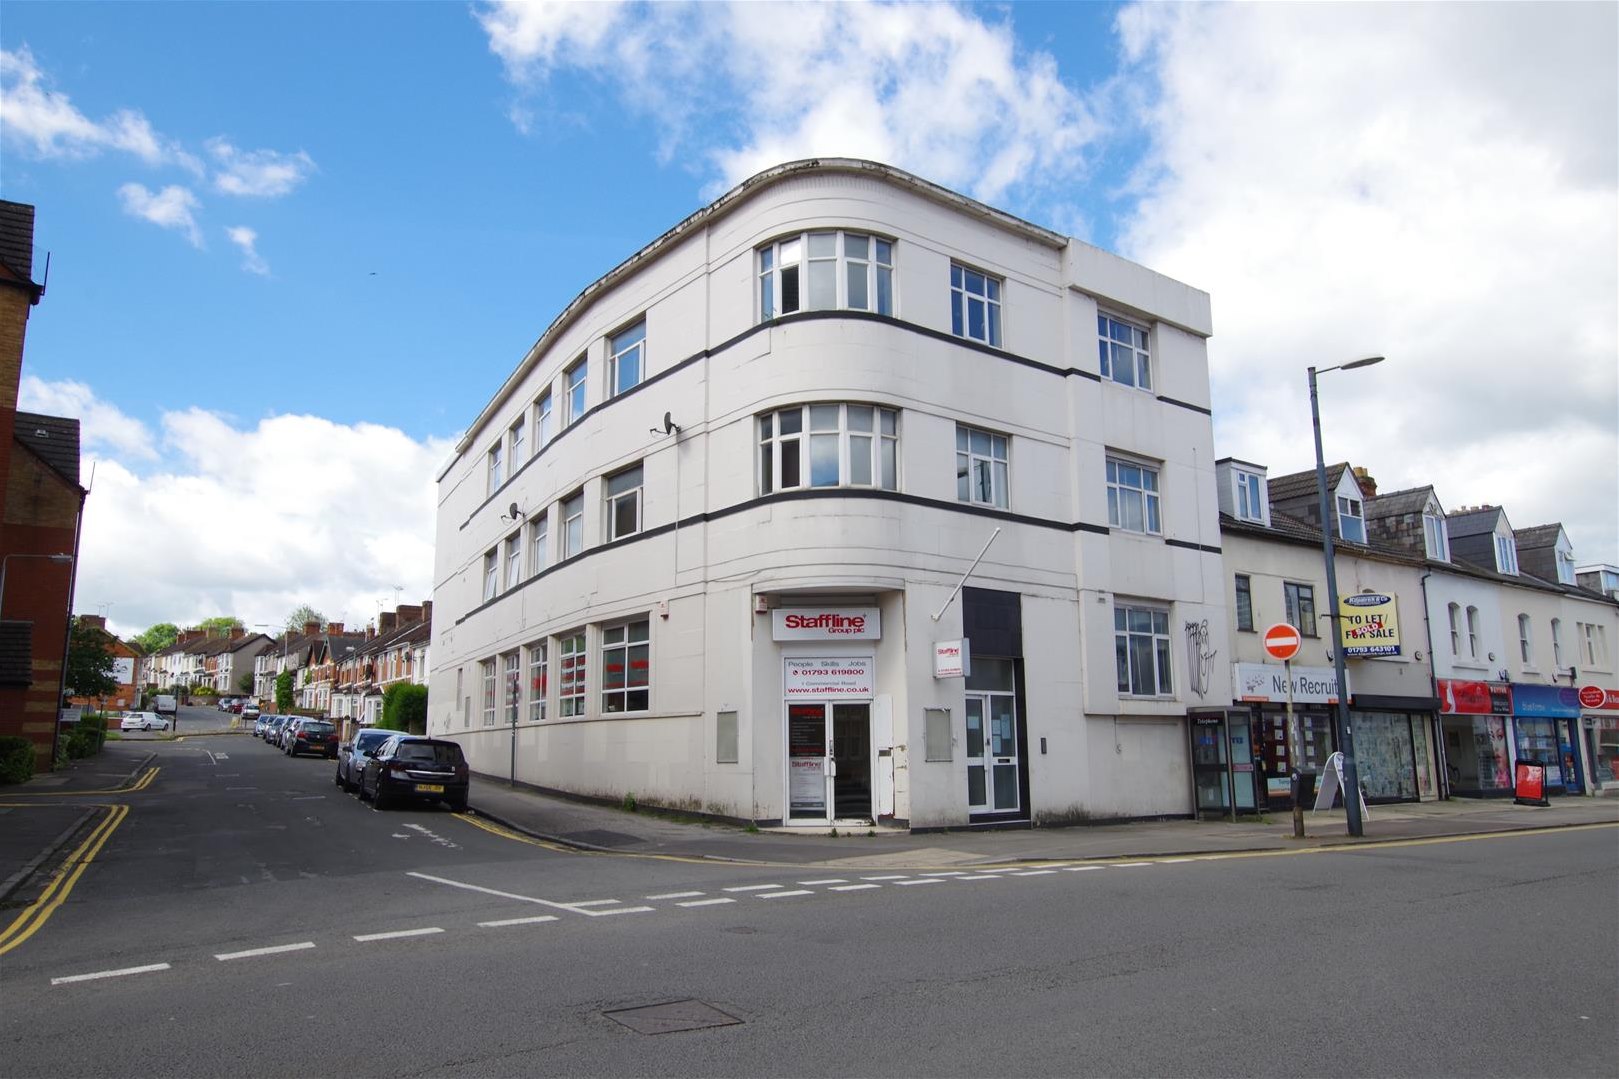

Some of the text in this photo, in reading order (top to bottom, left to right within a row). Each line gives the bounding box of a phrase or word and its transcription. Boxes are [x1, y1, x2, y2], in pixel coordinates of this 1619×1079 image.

[785, 614, 865, 628] Staffline
[1350, 615, 1361, 624] TO
[1356, 623, 1378, 635] SOLD
